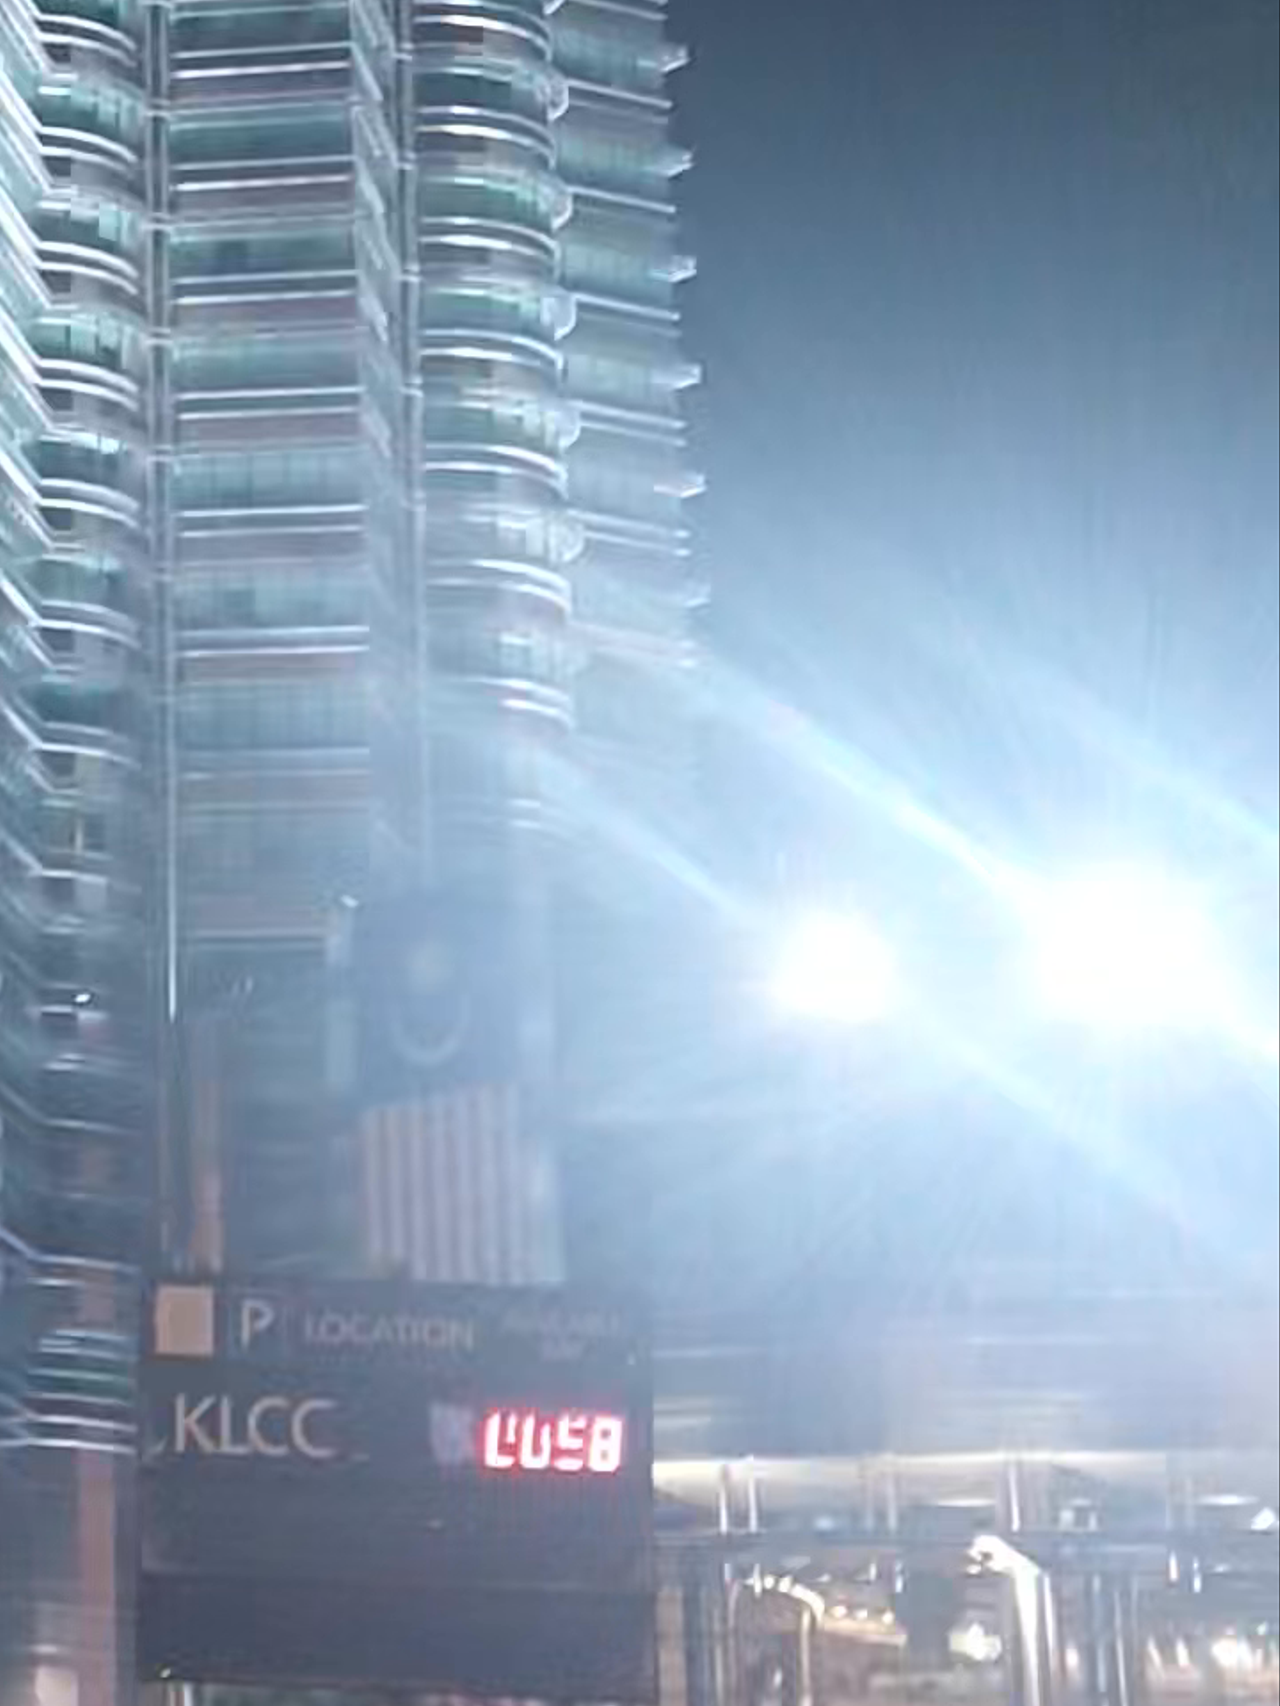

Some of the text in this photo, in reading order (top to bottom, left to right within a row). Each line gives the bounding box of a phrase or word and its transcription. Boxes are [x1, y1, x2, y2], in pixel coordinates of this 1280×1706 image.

[241, 1298, 275, 1349] P
[304, 1314, 474, 1352] LOCATION
[175, 1392, 338, 1459] KLCC
